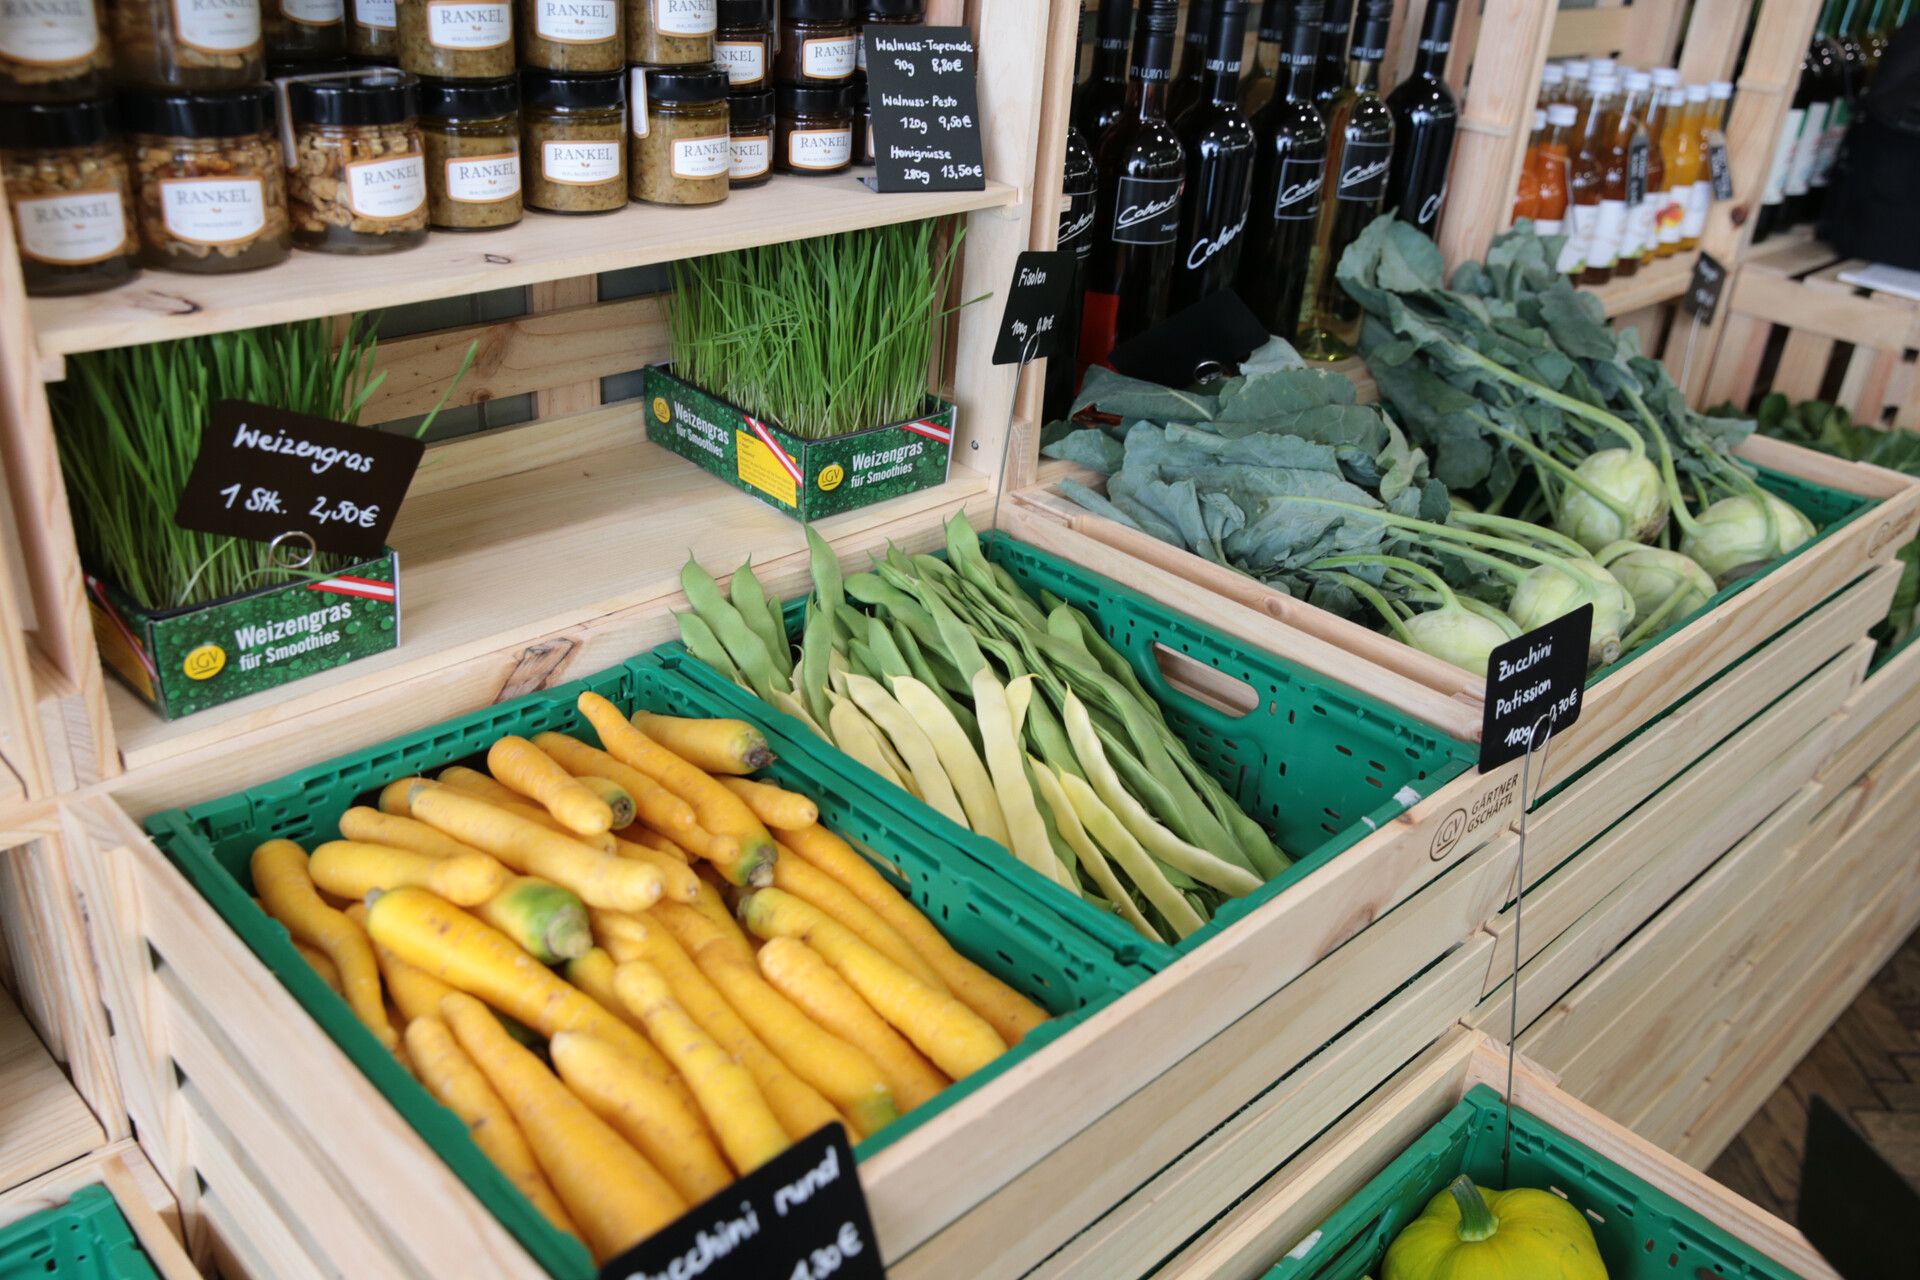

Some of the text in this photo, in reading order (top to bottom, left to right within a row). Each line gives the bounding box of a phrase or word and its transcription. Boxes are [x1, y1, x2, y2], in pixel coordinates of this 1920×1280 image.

[441, 9, 504, 24] RANKEL
[547, 3, 609, 19] RANKEL
[875, 37, 973, 54] Walnuss-Tapenade
[894, 58, 964, 77] 90g 8,80€
[932, 95, 958, 107] Pesto
[900, 115, 973, 134] 120g 9,50€
[801, 136, 848, 149] RANKEL
[554, 147, 613, 161] RANKEL
[890, 144, 952, 163] Honignüsse
[364, 164, 419, 186] RANKEL
[460, 162, 516, 180] RANKEL
[903, 164, 983, 185] 280g 13,50€
[176, 188, 252, 206] RANKEL
[35, 202, 112, 223] RANKEL
[1018, 267, 1047, 287] Fisolen
[674, 400, 729, 445] Weizengras
[233, 422, 374, 474] Weizengras
[687, 428, 724, 458] Smoothies
[852, 441, 923, 472] Weizengras
[822, 469, 840, 484] LGV
[851, 462, 913, 488] für Smoothies
[220, 483, 380, 528] 1 Stk. 2,50€
[234, 602, 352, 650] Weizengras
[190, 649, 218, 671] LGV
[238, 628, 341, 672] für Smoothies
[1498, 636, 1553, 682] Zucchini
[1495, 679, 1552, 720] Patission
[1504, 725, 1531, 747] 100g
[774, 1145, 840, 1217] rund
